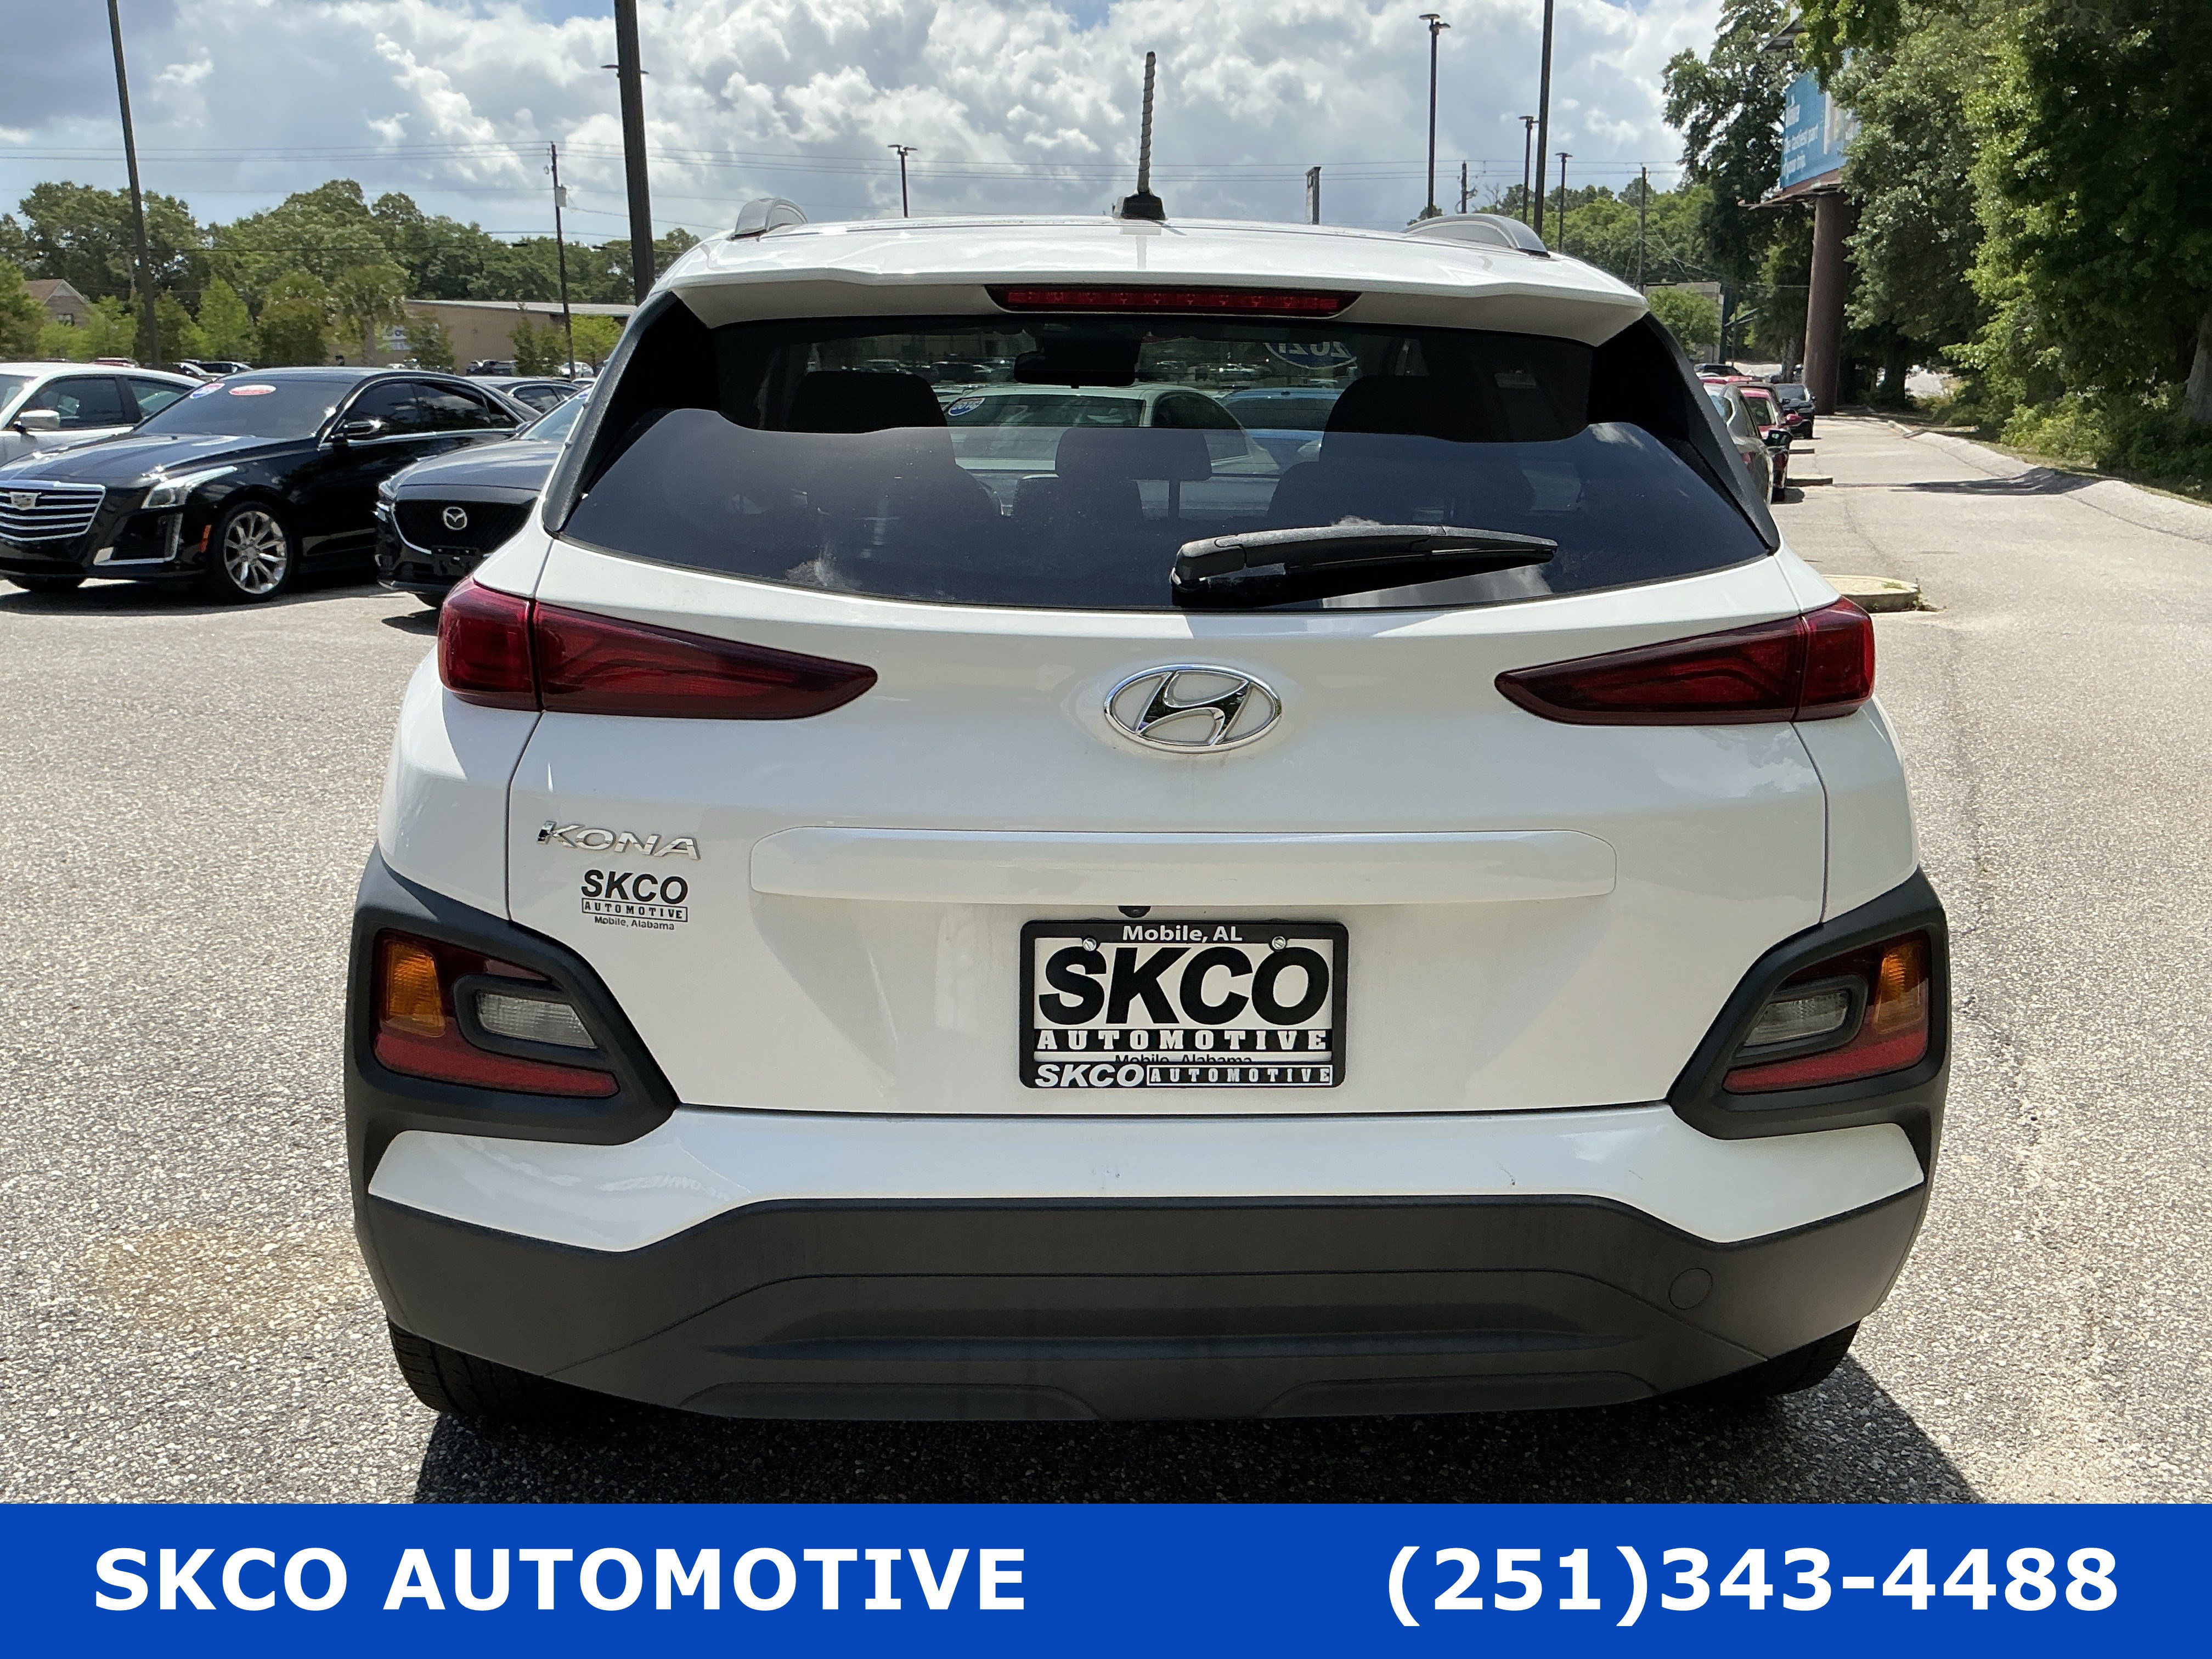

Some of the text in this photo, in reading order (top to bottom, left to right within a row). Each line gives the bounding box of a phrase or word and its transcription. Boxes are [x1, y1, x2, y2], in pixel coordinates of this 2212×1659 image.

[537, 820, 701, 860] KONA
[582, 870, 689, 905] SKCO
[584, 901, 683, 919] AUTOMOTIVE
[594, 916, 675, 931] Mobile, Alabama
[1122, 924, 1243, 943] Mobile, AL
[1039, 946, 1330, 1026] SKCO
[1037, 1029, 1327, 1051] AUTOMOTIVE
[1182, 1054, 1253, 1063] Alabama
[1035, 1063, 1330, 1087] SKCO AUTOMOTIVE
